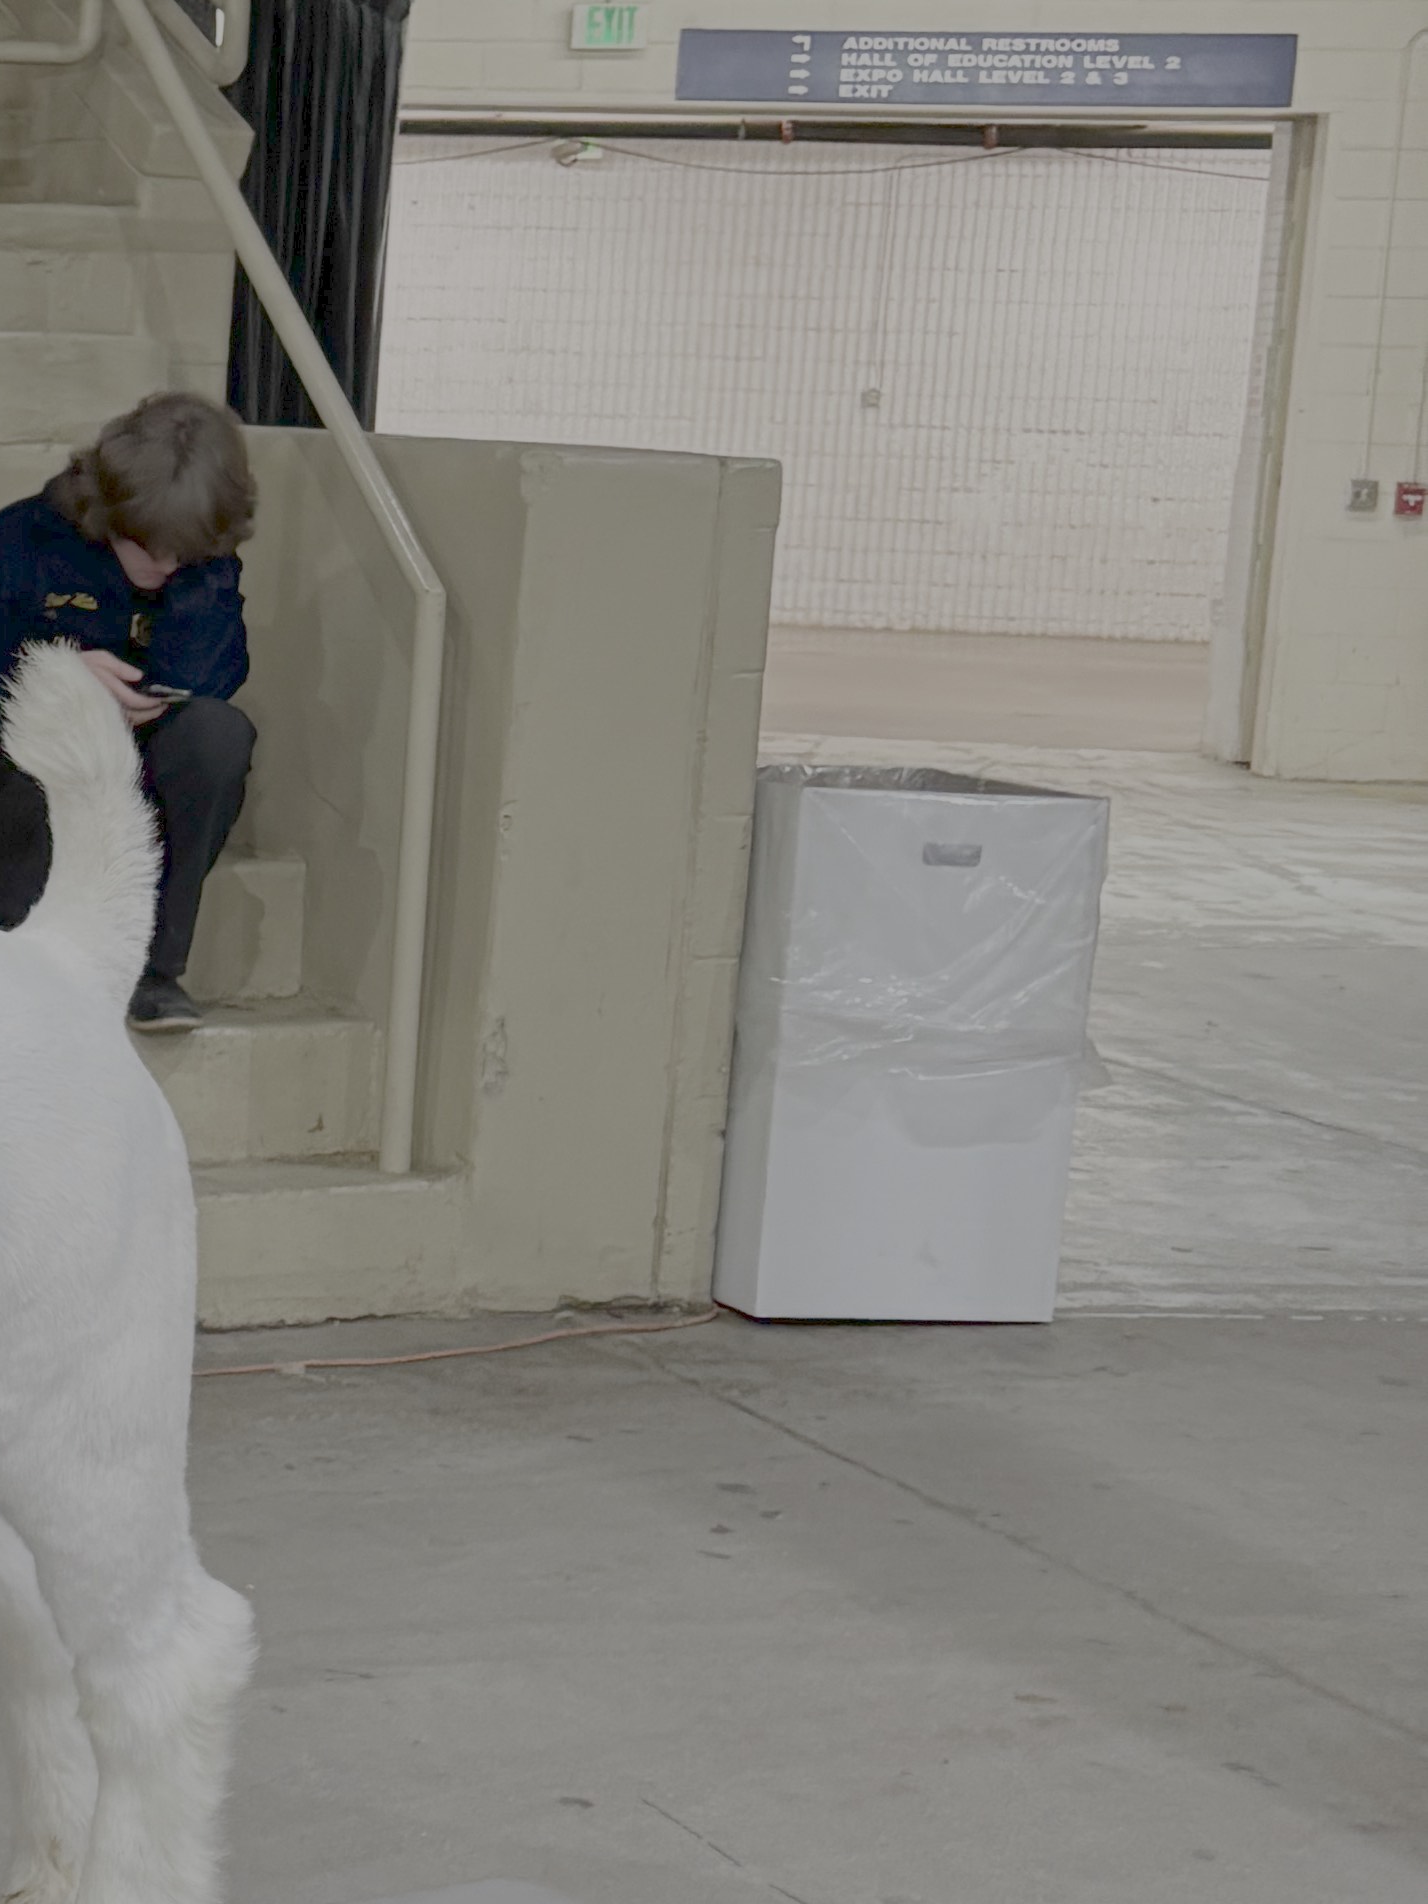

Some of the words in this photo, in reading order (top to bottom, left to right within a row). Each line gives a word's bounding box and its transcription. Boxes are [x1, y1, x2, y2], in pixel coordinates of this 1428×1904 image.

[585, 5, 638, 45] EXIT
[842, 37, 972, 51] ADDITIONAL
[981, 38, 1120, 52] RESTROOMS
[841, 52, 897, 66] HALL
[907, 53, 938, 67] OF
[948, 54, 1073, 68] EDUCATION
[1083, 55, 1155, 69] LEVEL
[1165, 56, 1181, 70] 2
[840, 68, 903, 82] EXPO
[913, 69, 969, 83] HALL
[978, 70, 1050, 84] LEVEL
[1060, 71, 1075, 85] 2
[1085, 72, 1102, 85] &
[1113, 72, 1128, 85] 3
[839, 84, 893, 98] EXIT
